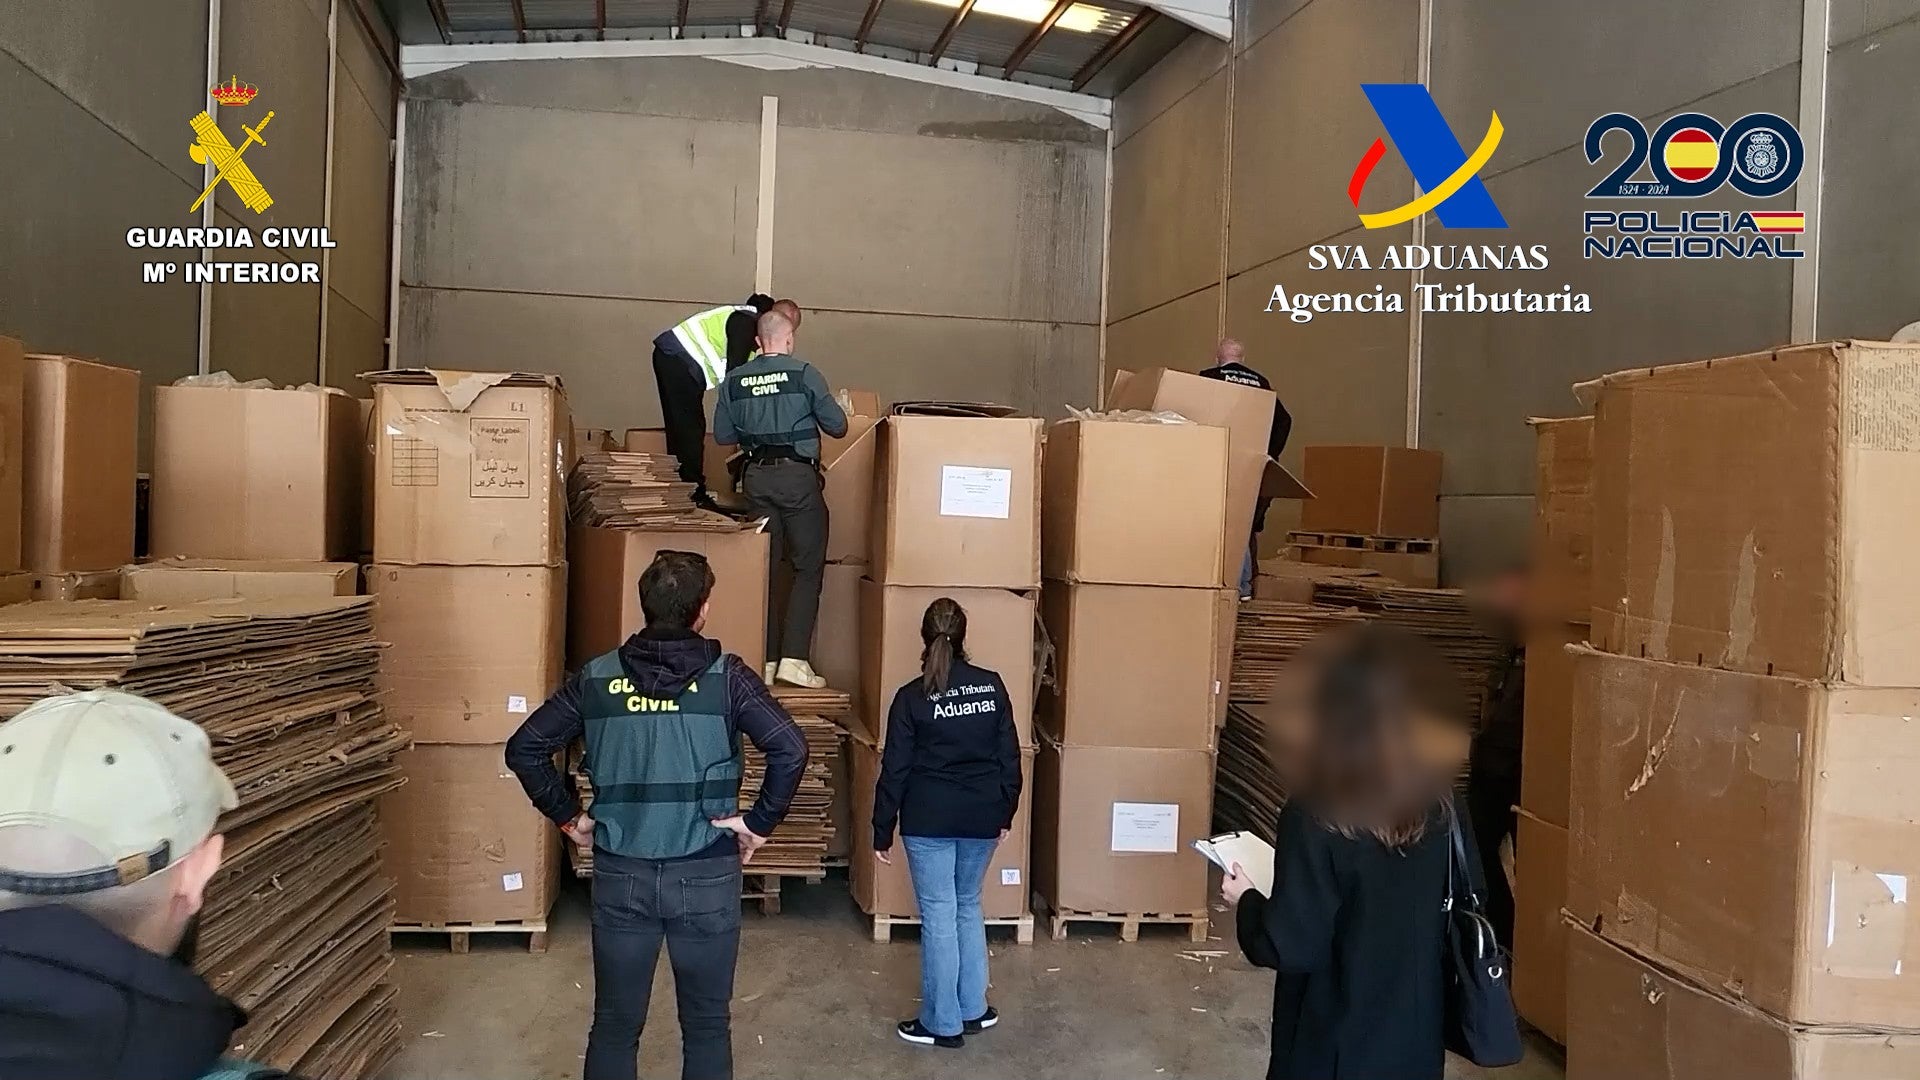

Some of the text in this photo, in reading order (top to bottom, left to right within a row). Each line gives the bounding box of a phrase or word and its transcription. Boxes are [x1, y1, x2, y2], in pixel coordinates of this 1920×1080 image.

[740, 372, 789, 387] GUARDIA
[751, 384, 780, 396] CIVIL
[960, 683, 996, 696] Tributaria
[626, 695, 680, 712] CIVIL
[933, 700, 997, 720] Aduanas
